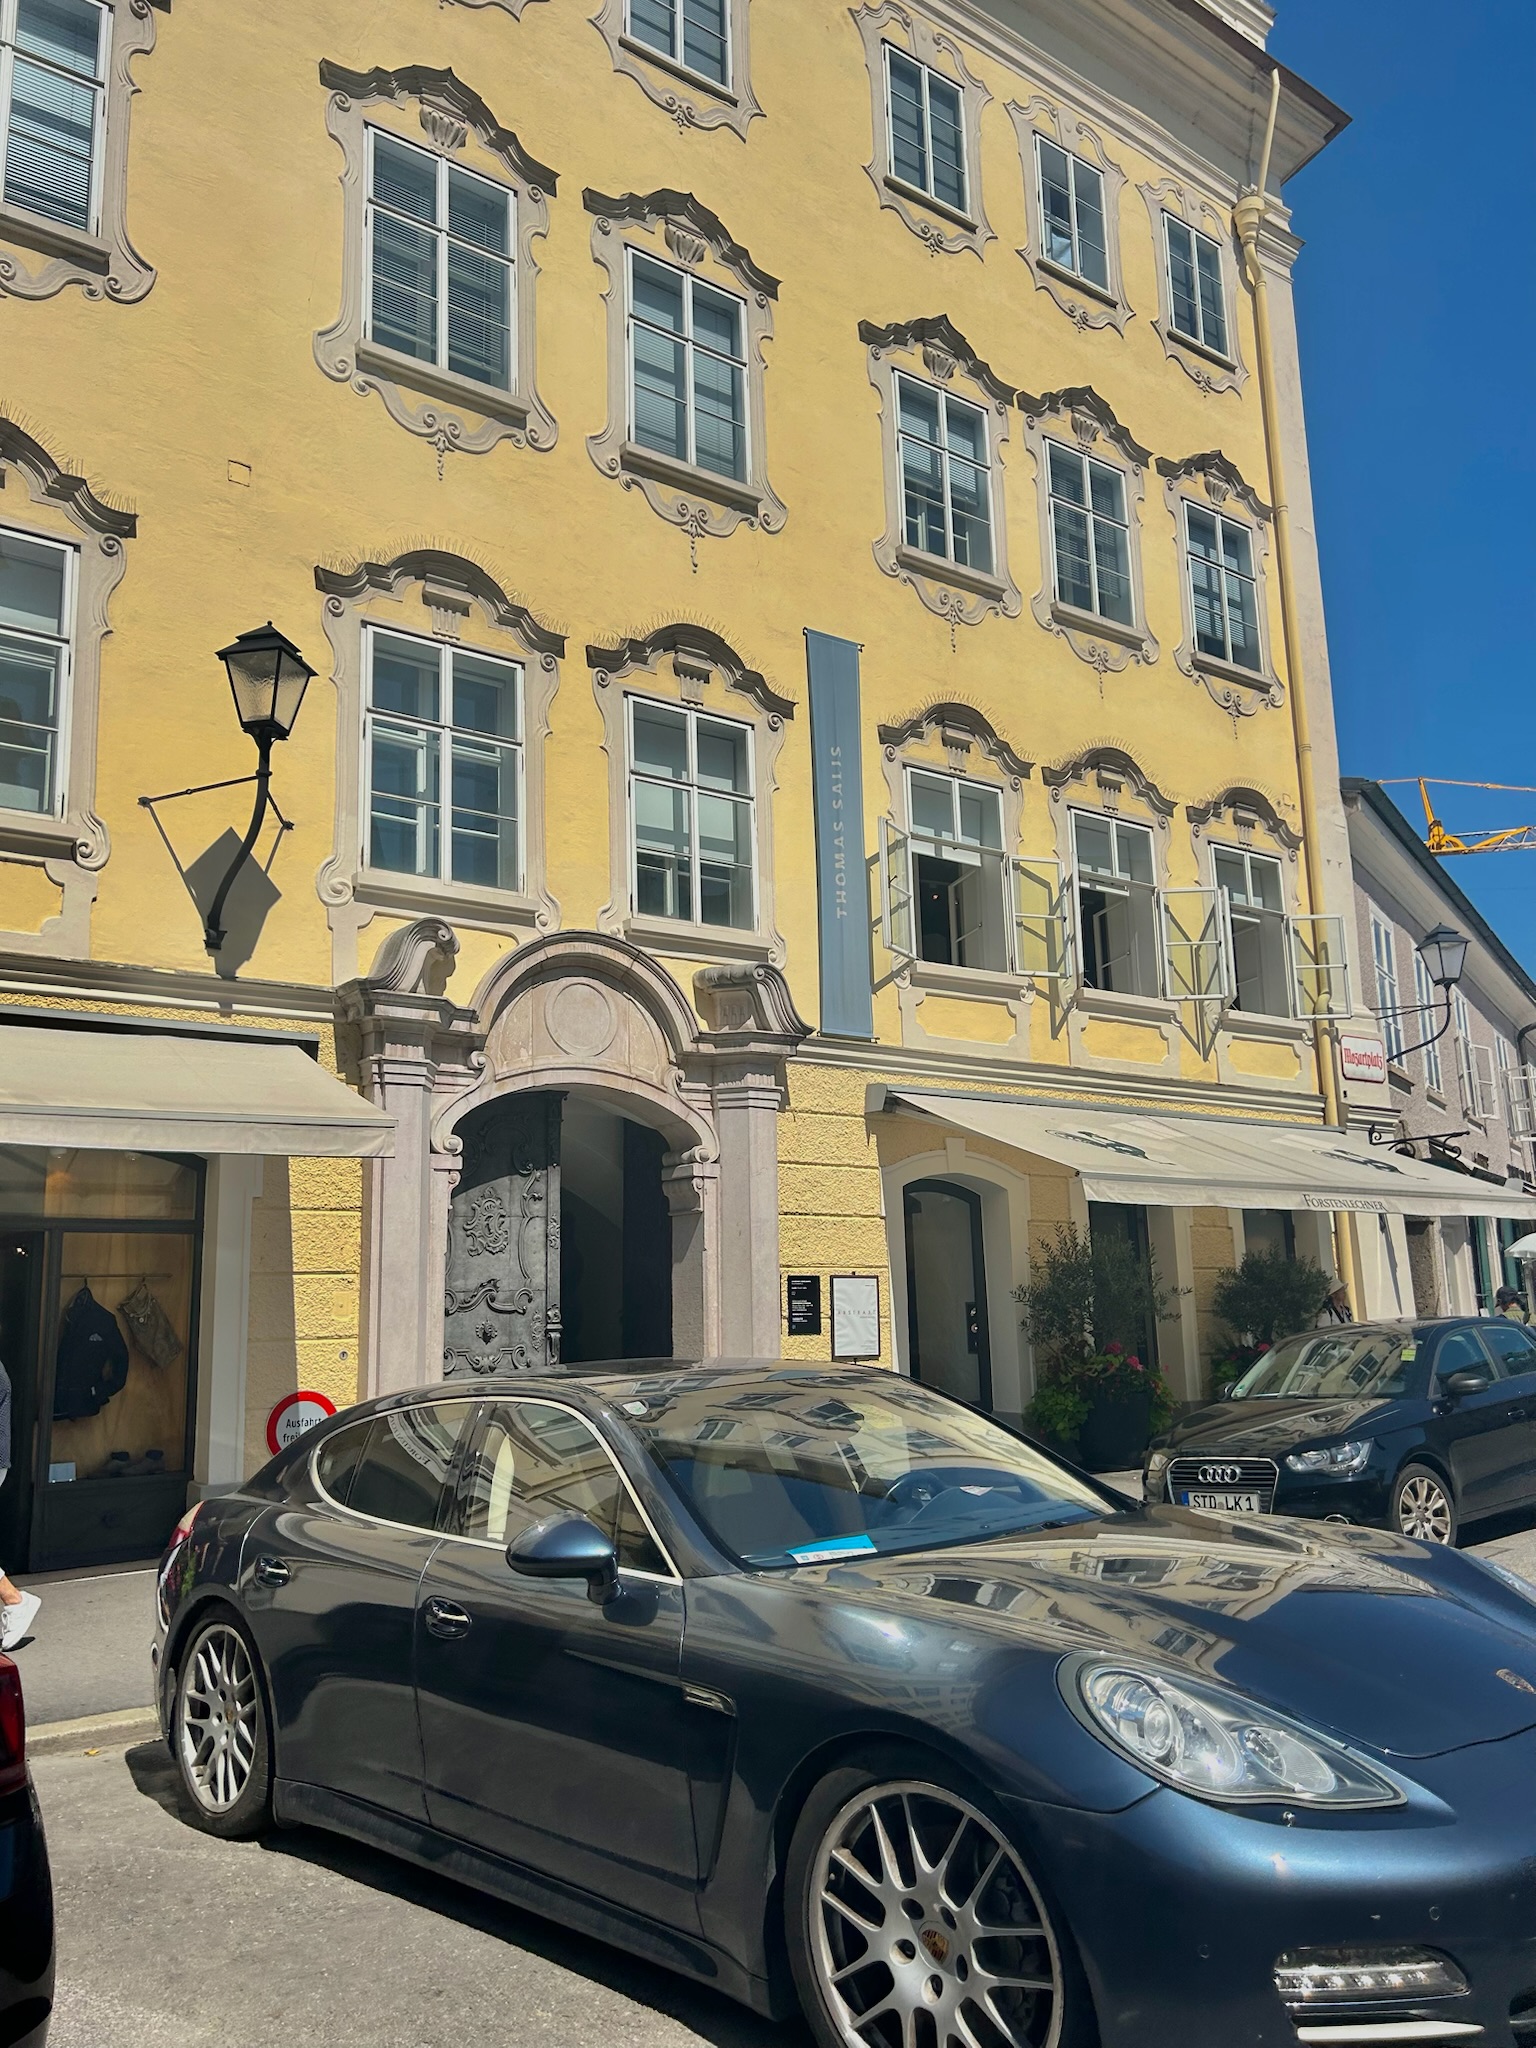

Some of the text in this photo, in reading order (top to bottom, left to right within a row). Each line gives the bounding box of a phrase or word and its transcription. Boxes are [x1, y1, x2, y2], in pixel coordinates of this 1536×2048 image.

[831, 746, 848, 919] THOMAS SALIS
[1344, 1047, 1383, 1071] Mozartplatz
[1193, 1494, 1217, 1508] STD
